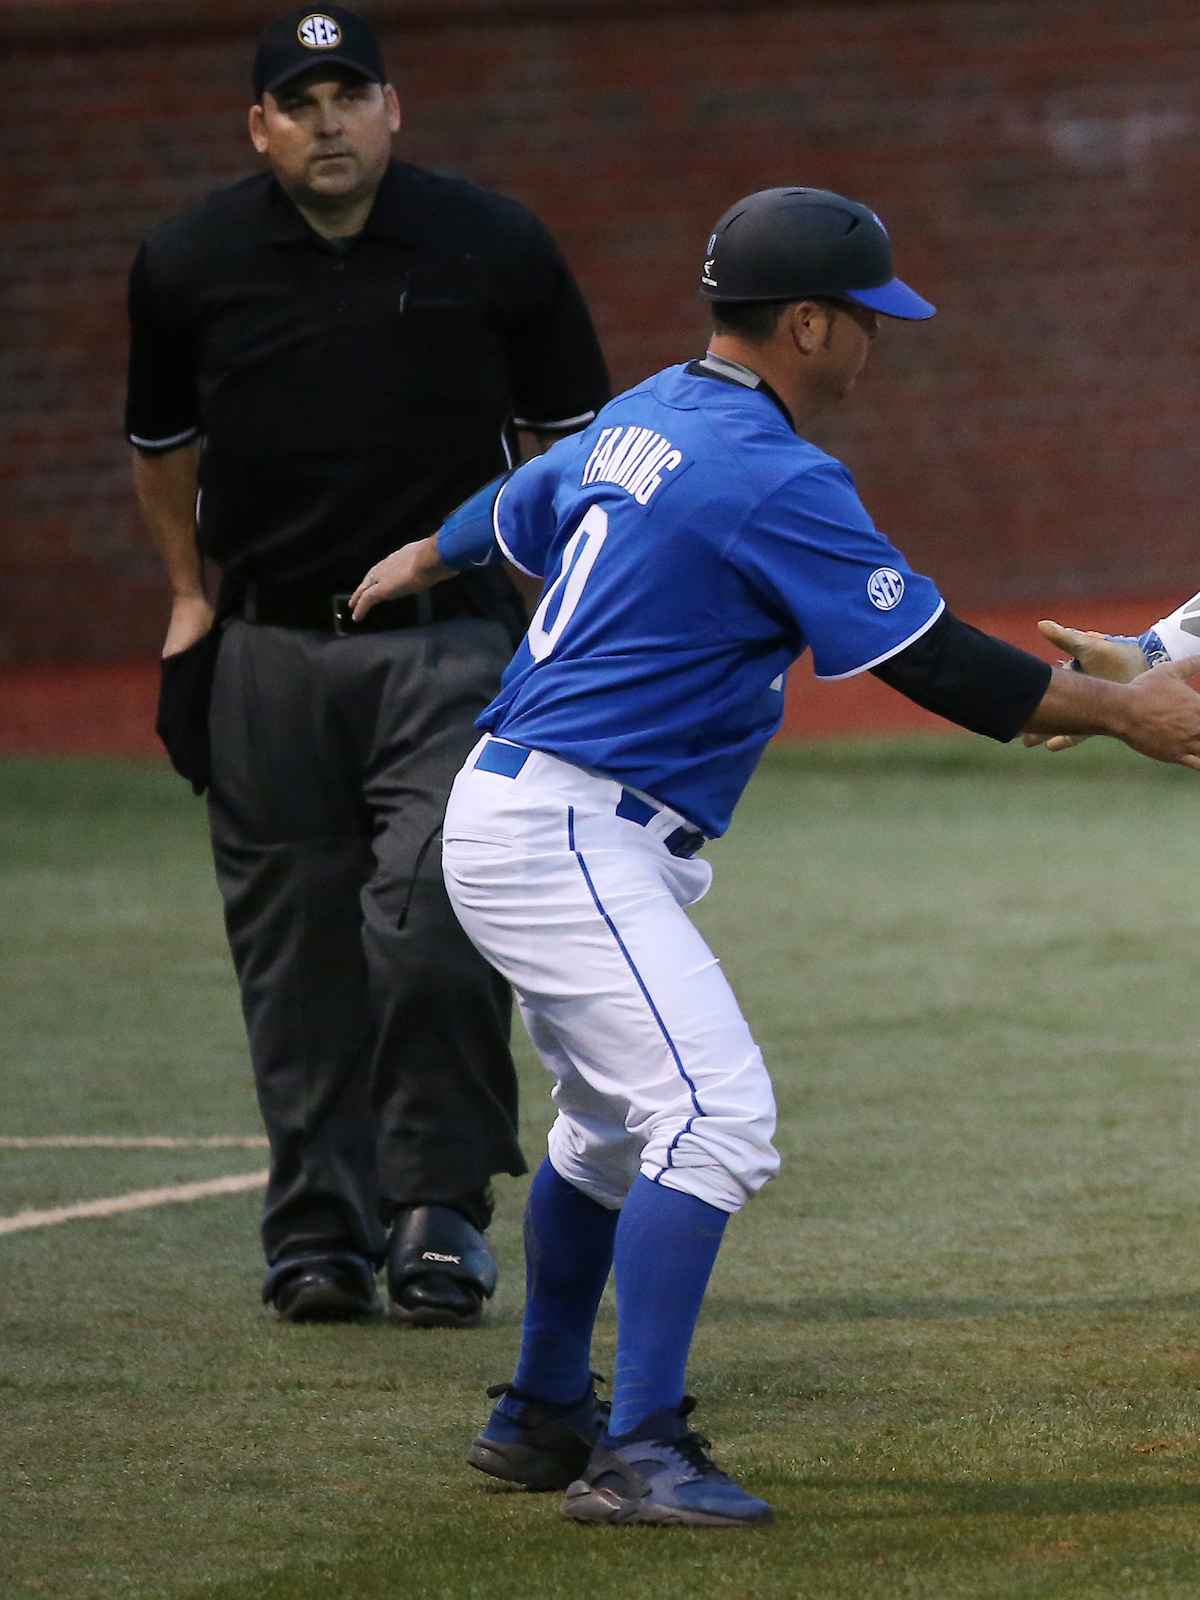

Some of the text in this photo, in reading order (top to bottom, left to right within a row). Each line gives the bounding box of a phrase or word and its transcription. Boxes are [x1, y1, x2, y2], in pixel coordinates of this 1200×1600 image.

[301, 16, 339, 46] SEC
[581, 426, 683, 505] FANNING
[528, 503, 609, 664] 0
[870, 570, 902, 608] SEC
